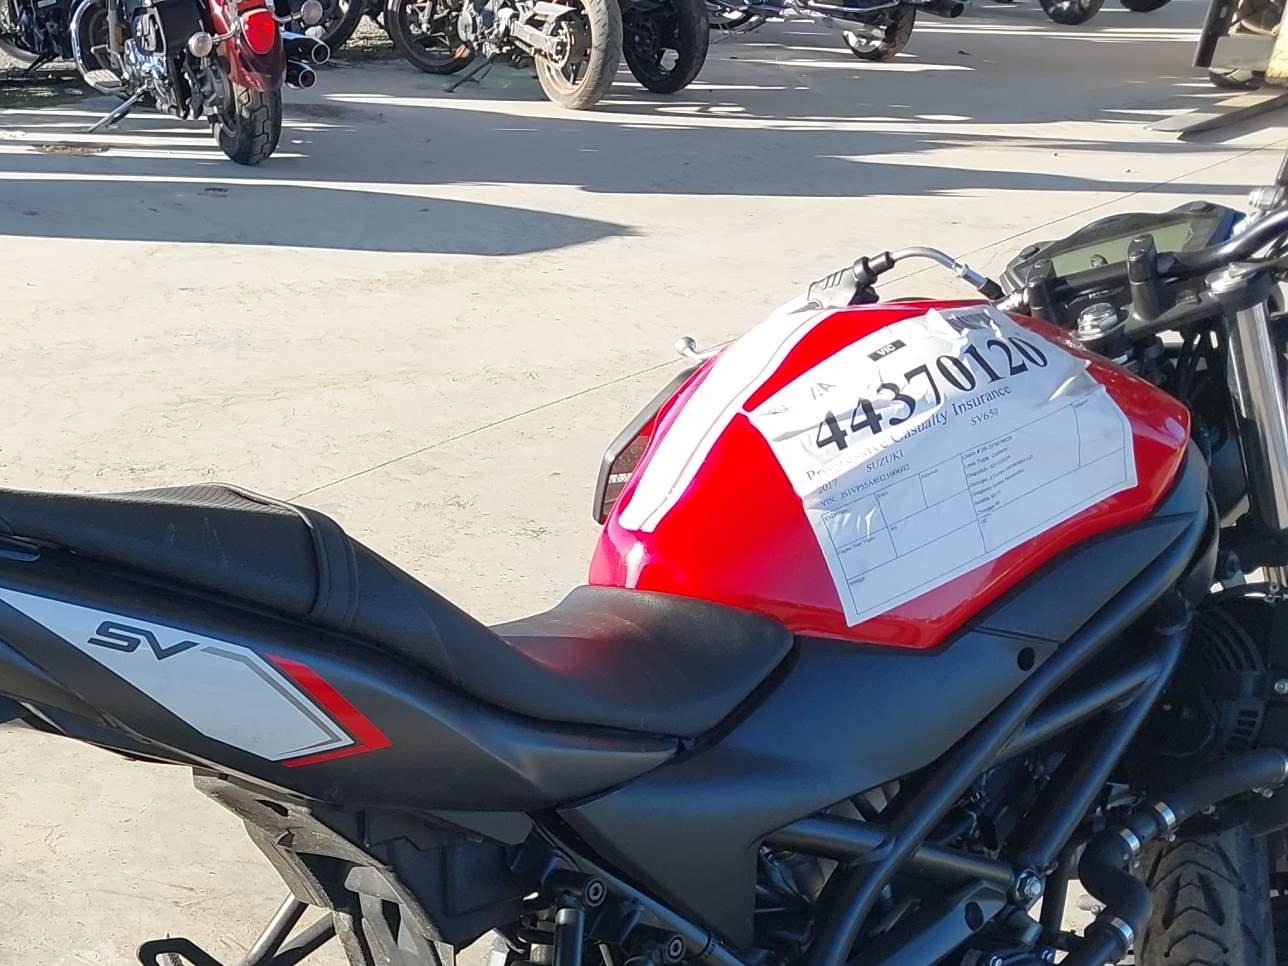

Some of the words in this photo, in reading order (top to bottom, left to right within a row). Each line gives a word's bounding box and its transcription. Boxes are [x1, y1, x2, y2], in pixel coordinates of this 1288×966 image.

[876, 344, 896, 357] VIC
[816, 336, 1048, 451] 44370120
[891, 410, 949, 443] Casualty
[951, 384, 1012, 417] Insurance
[817, 478, 839, 494] 2017
[865, 448, 905, 473] SUZUKI
[970, 407, 1000, 427] SV650
[87, 620, 201, 661] SV
